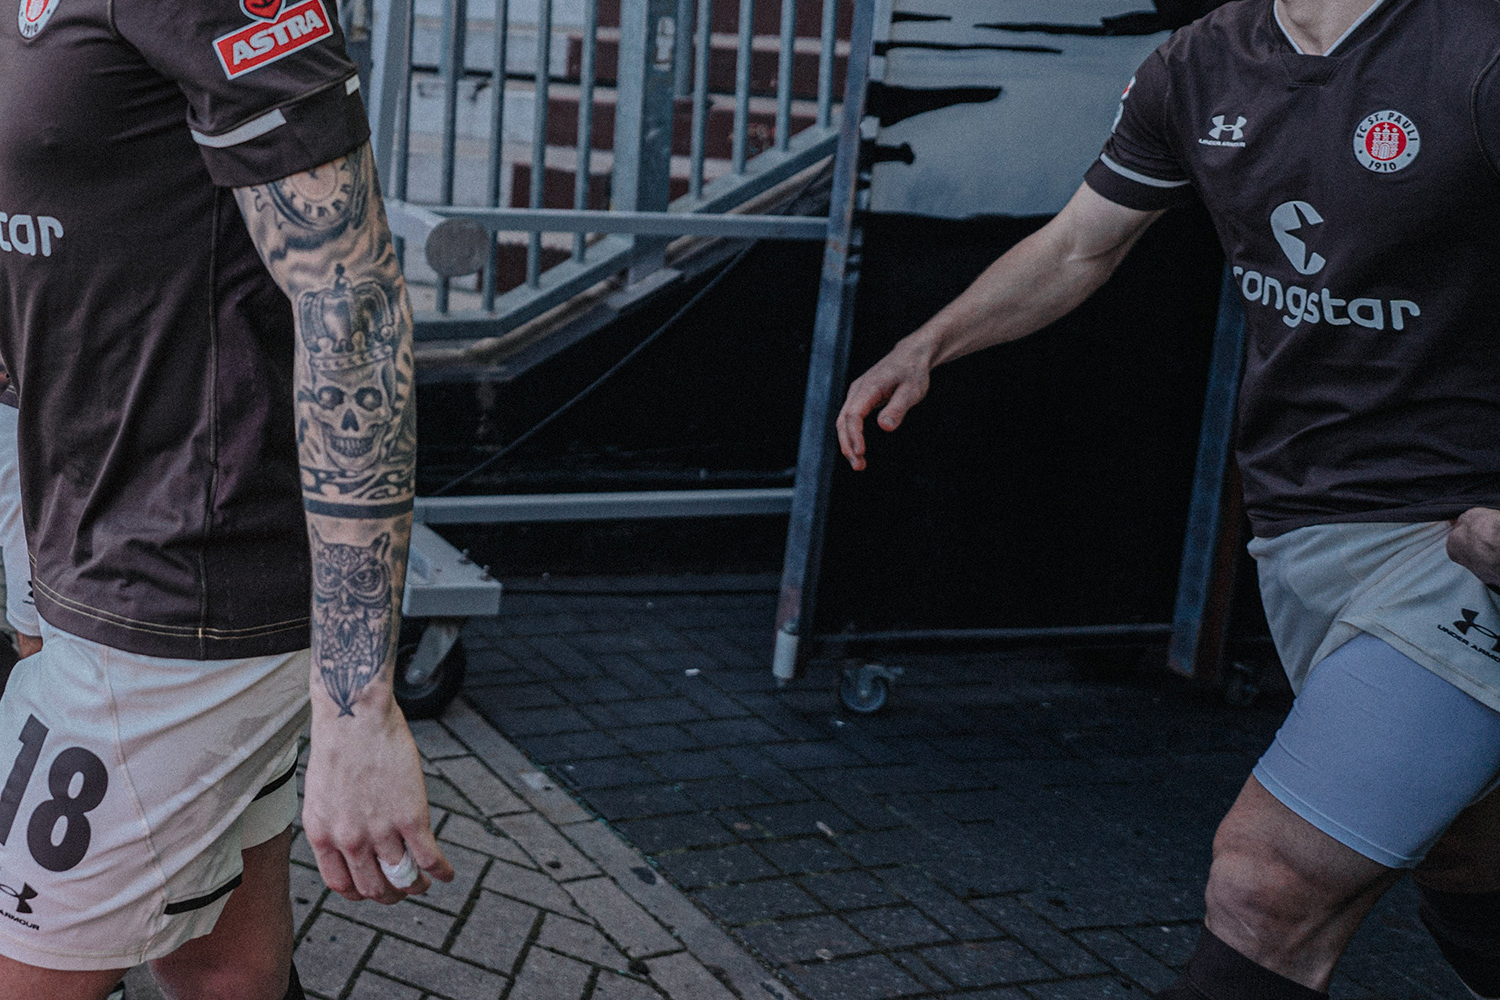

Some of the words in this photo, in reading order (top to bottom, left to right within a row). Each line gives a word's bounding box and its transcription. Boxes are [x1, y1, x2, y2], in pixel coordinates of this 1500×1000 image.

[232, 8, 325, 66] ASTRA
[1356, 126, 1368, 139] FC
[1368, 113, 1384, 126] ST.
[1387, 112, 1419, 141] PAULI
[1368, 160, 1397, 171] 1910
